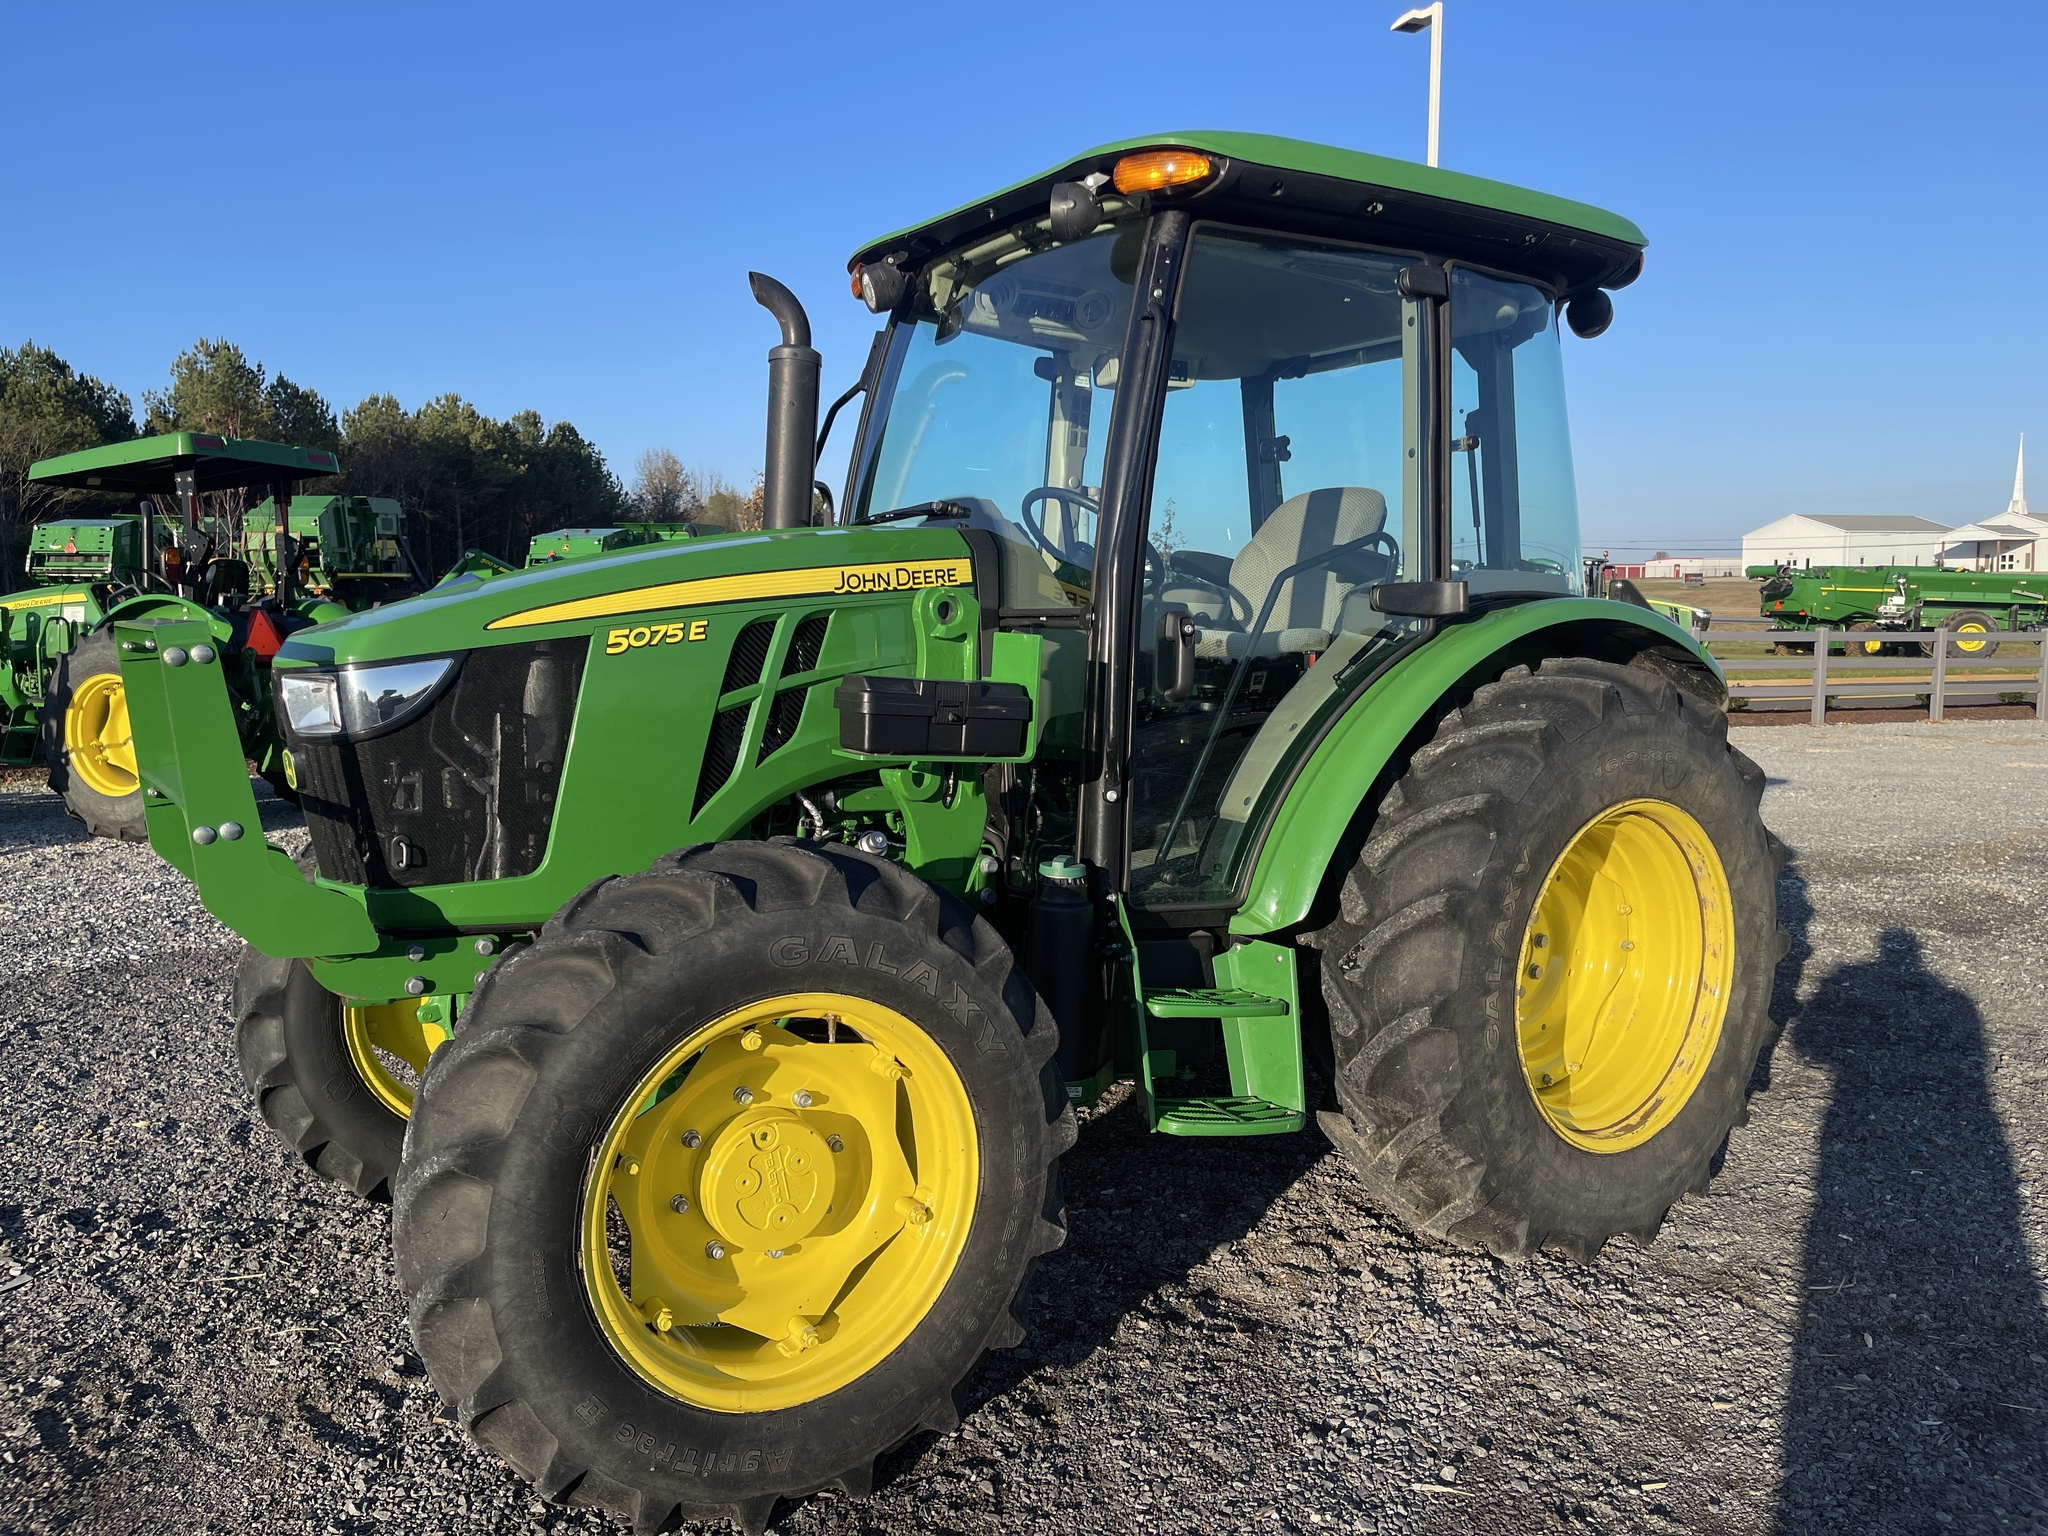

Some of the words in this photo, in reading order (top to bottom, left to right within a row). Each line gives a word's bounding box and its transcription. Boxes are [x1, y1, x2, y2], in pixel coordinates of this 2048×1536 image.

[834, 570, 892, 591] JOHN
[895, 567, 960, 587] DEERE
[30, 599, 53, 607] DEERE
[604, 622, 685, 656] 5075
[688, 619, 709, 643] E
[1484, 846, 1532, 1051] GALAXY
[768, 935, 1009, 1055] GALAXY
[764, 1152, 780, 1190] LEVEL
